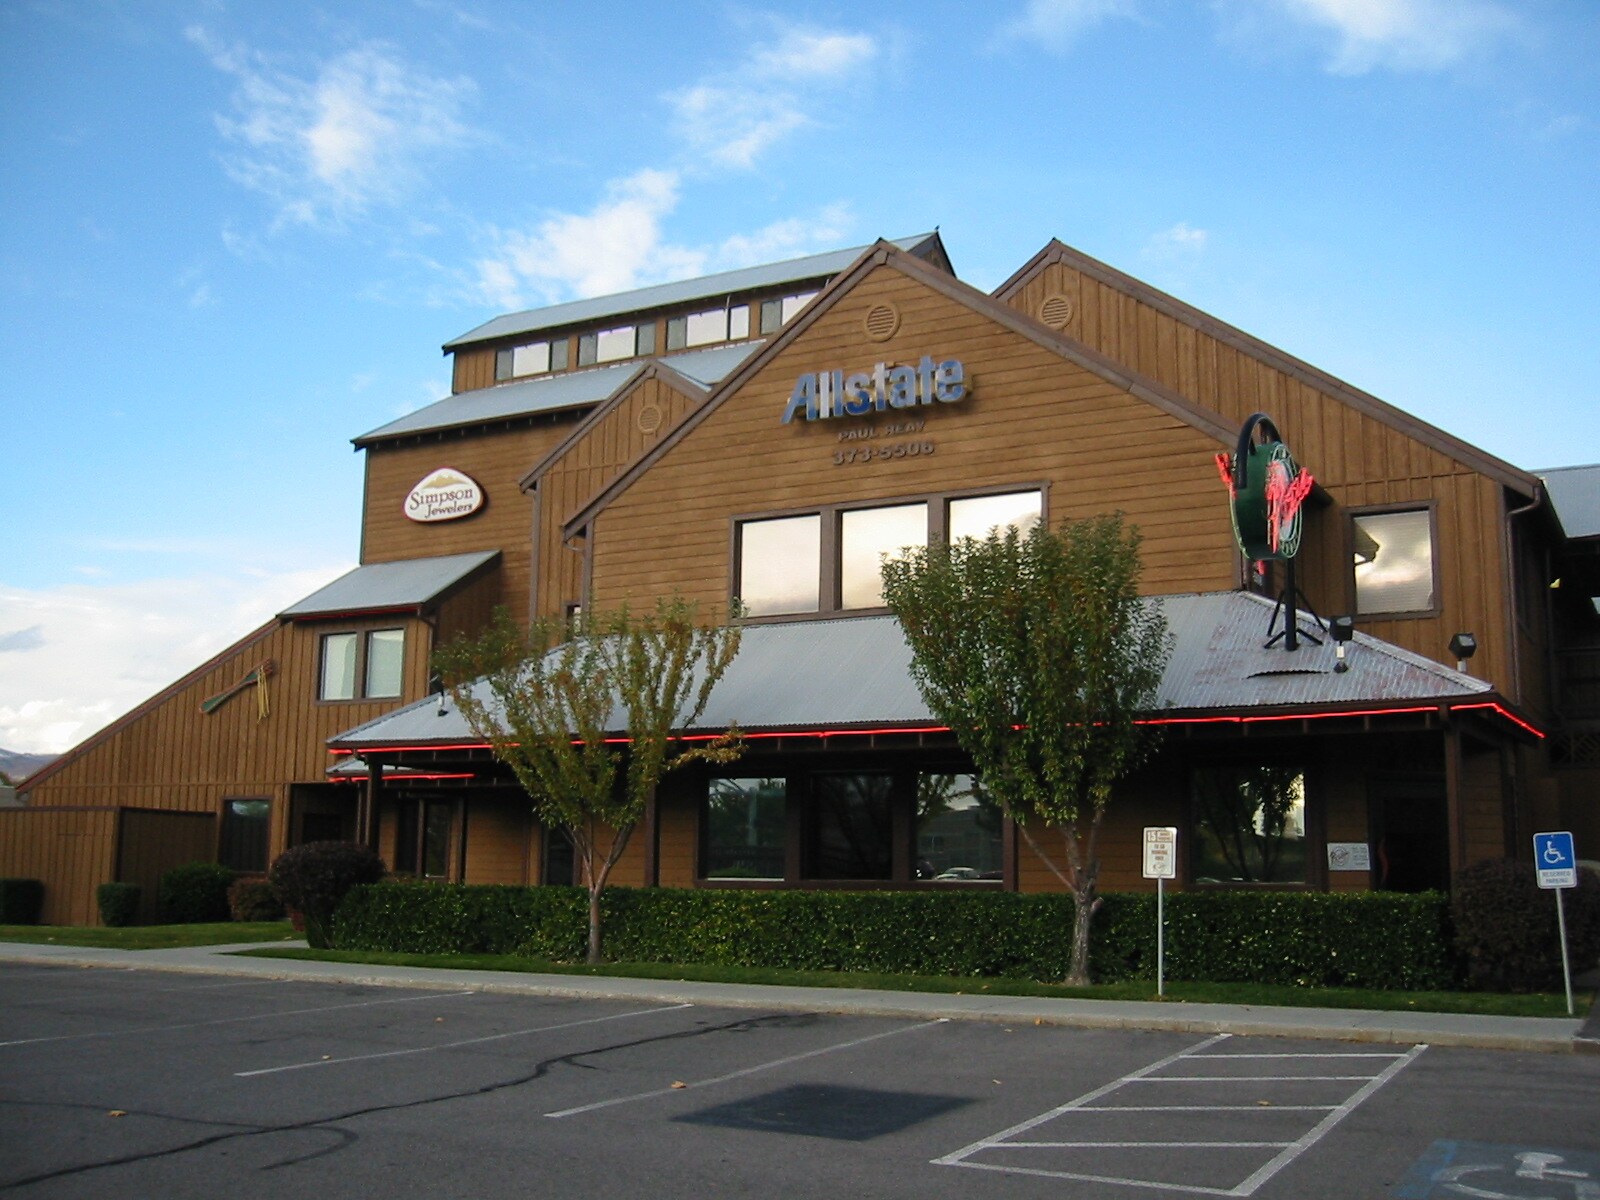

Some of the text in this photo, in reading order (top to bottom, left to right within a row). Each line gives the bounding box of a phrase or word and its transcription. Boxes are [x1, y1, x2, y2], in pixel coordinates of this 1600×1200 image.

[780, 355, 966, 425] Allstate
[838, 427, 879, 442] PAUL
[410, 488, 473, 511] Simpson
[424, 501, 473, 519] Jewelers
